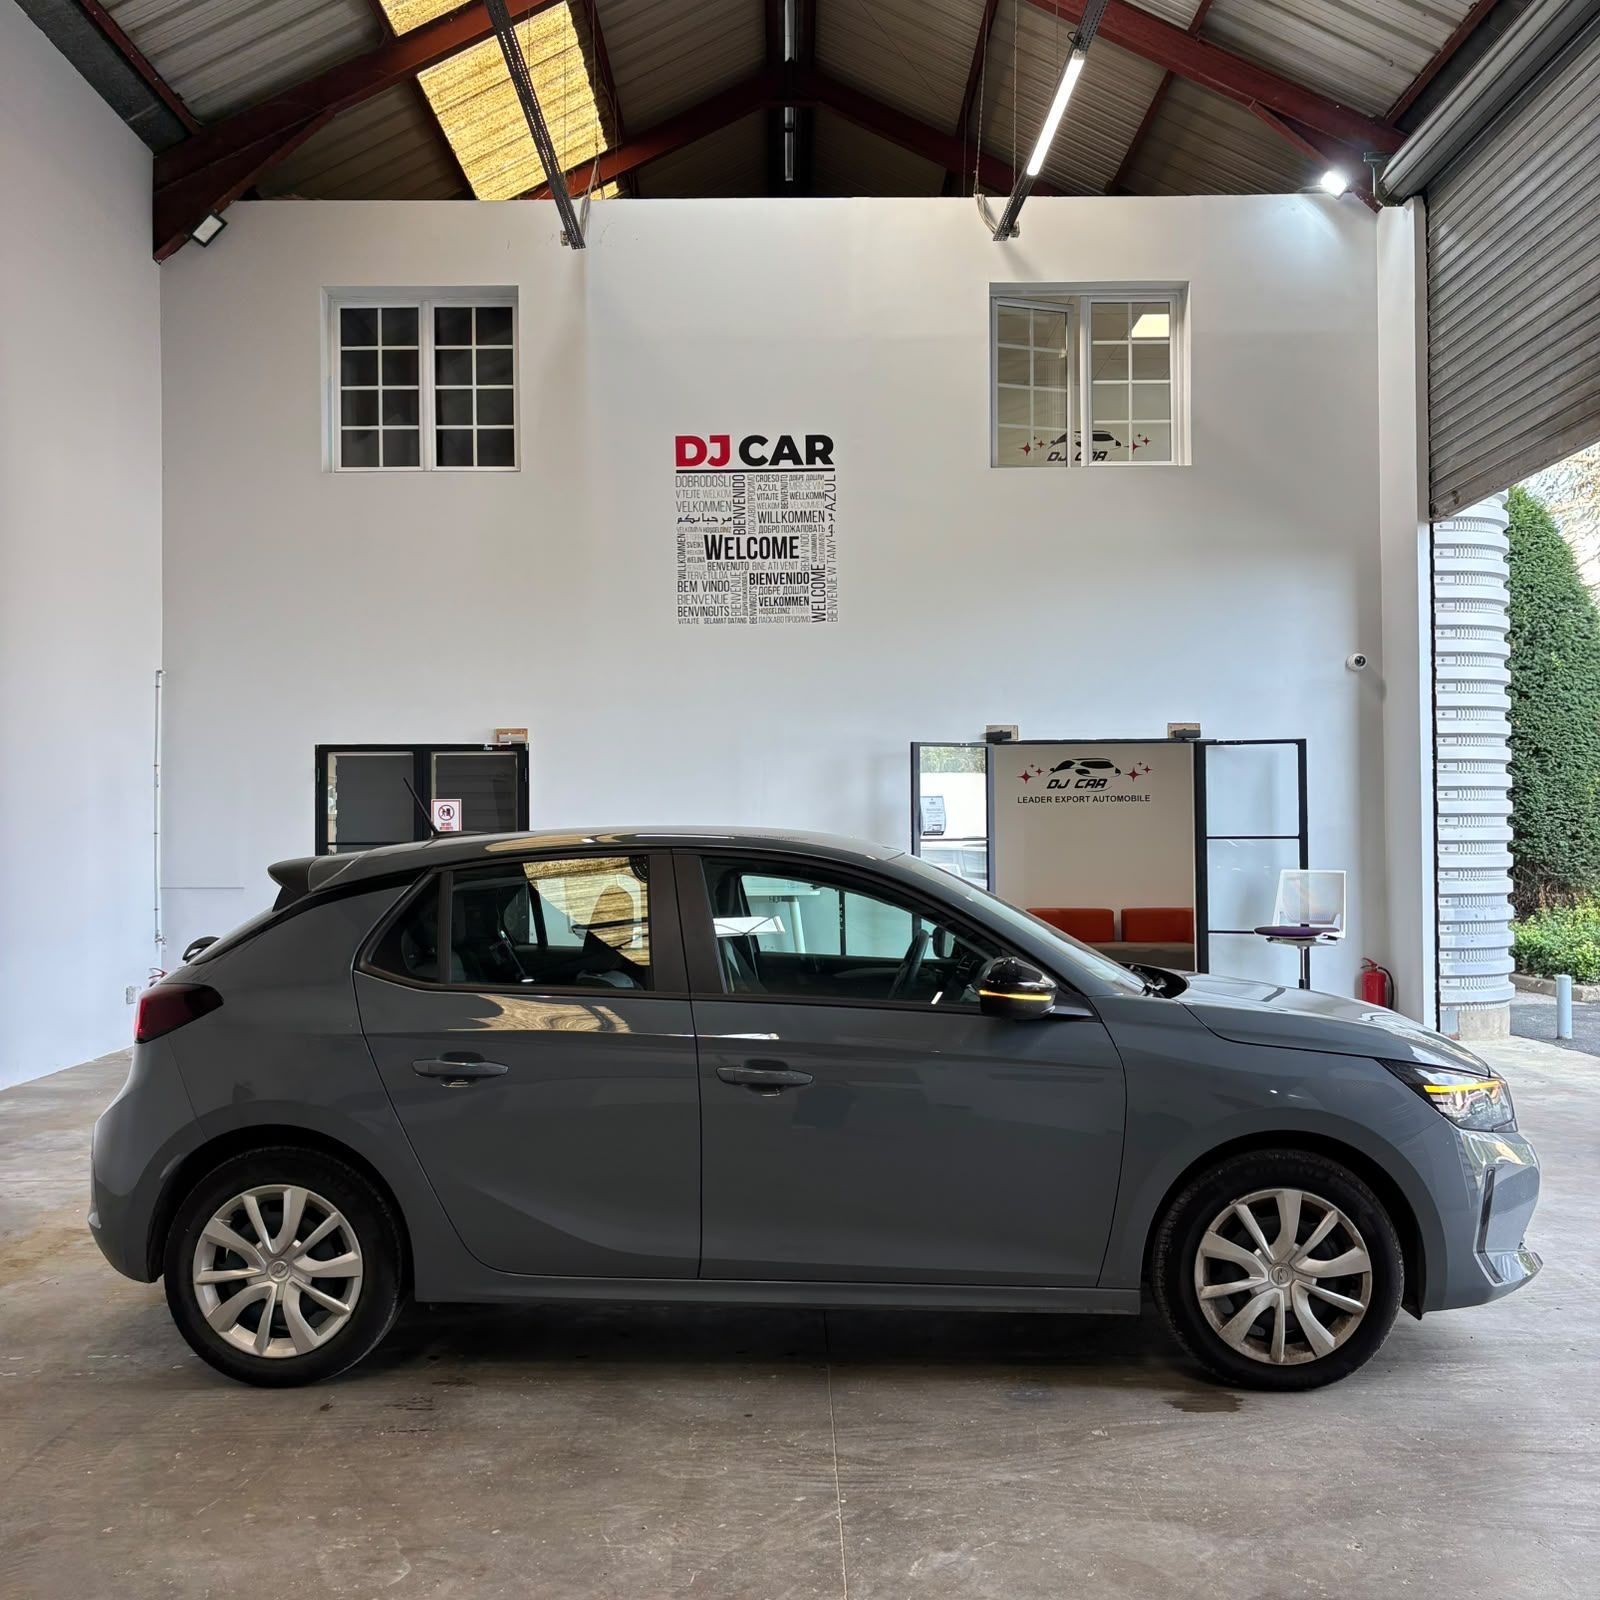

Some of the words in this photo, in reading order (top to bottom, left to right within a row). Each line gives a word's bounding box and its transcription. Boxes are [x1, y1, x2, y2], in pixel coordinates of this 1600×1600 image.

[675, 435, 731, 467] DJ
[738, 434, 834, 467] CAR
[757, 484, 779, 492] AZUL
[824, 474, 836, 512] AZUL
[676, 500, 732, 513] VELKOMMEN
[732, 474, 746, 535] BIENVENIDO
[757, 511, 825, 524] WILLKOMMEN
[704, 534, 800, 560] WELCOME
[707, 561, 750, 571] BENVENUTO
[748, 572, 810, 586] BIENVENIDO
[677, 580, 698, 593] BEM
[701, 580, 730, 593] VINDO
[677, 594, 729, 605] BIENVENUE
[810, 564, 826, 623] WELCOME
[758, 596, 810, 607] VELKOMMEN
[677, 605, 730, 618] BENVINGUTS
[1047, 779, 1070, 789] DJ
[1074, 779, 1108, 789] CAR
[1017, 796, 1053, 804] LEADER
[1055, 795, 1090, 804] EXPORT
[1092, 794, 1151, 803] AUTOMOBILE
